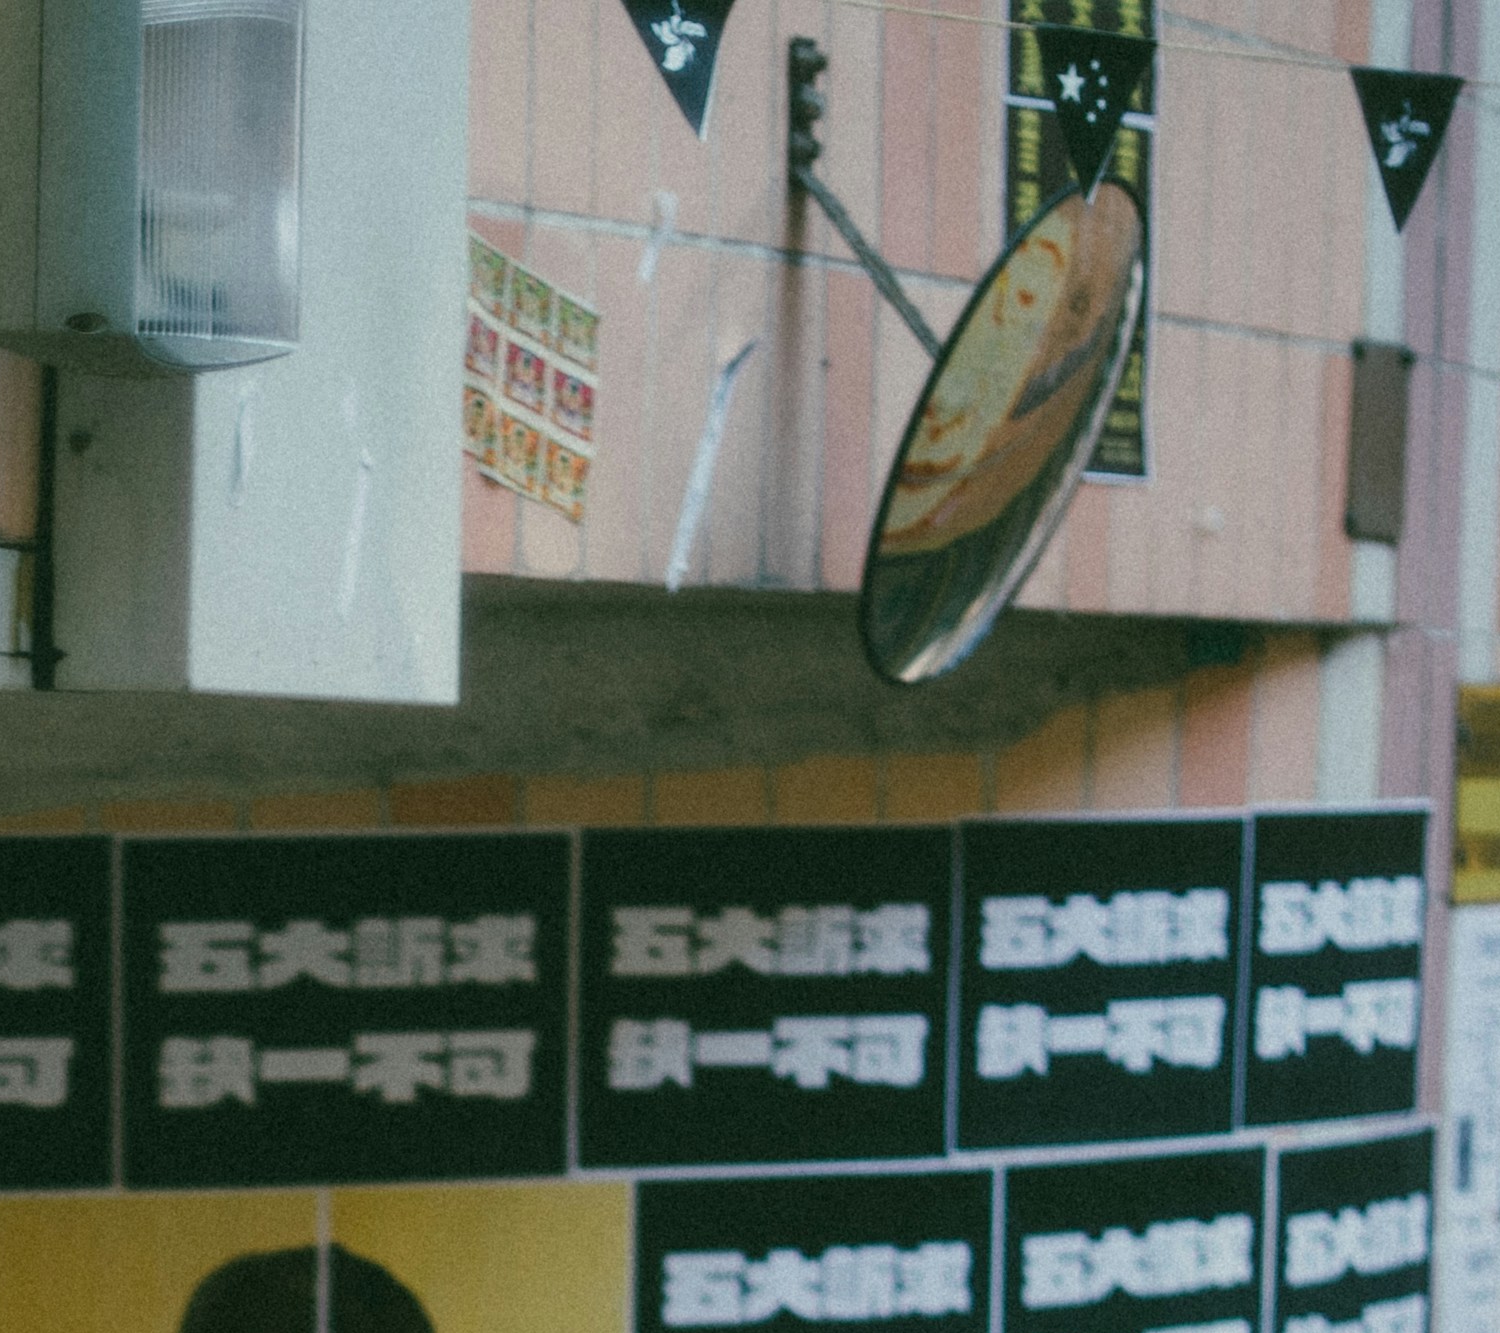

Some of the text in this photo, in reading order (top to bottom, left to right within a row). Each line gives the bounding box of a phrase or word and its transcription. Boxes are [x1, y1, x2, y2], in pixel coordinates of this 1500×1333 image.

[160, 915, 536, 992] 五大訴求
[614, 904, 930, 975] 五大訴求
[982, 890, 1227, 967] 五大訴求
[1258, 876, 1423, 954] 五大訴求
[611, 1015, 928, 1088] 缺一不可
[979, 997, 1224, 1077] 缺一不可
[1255, 977, 1419, 1061] 缺一不可
[160, 1030, 536, 1107] 缺一不可
[664, 1243, 970, 1325] 五大訴求
